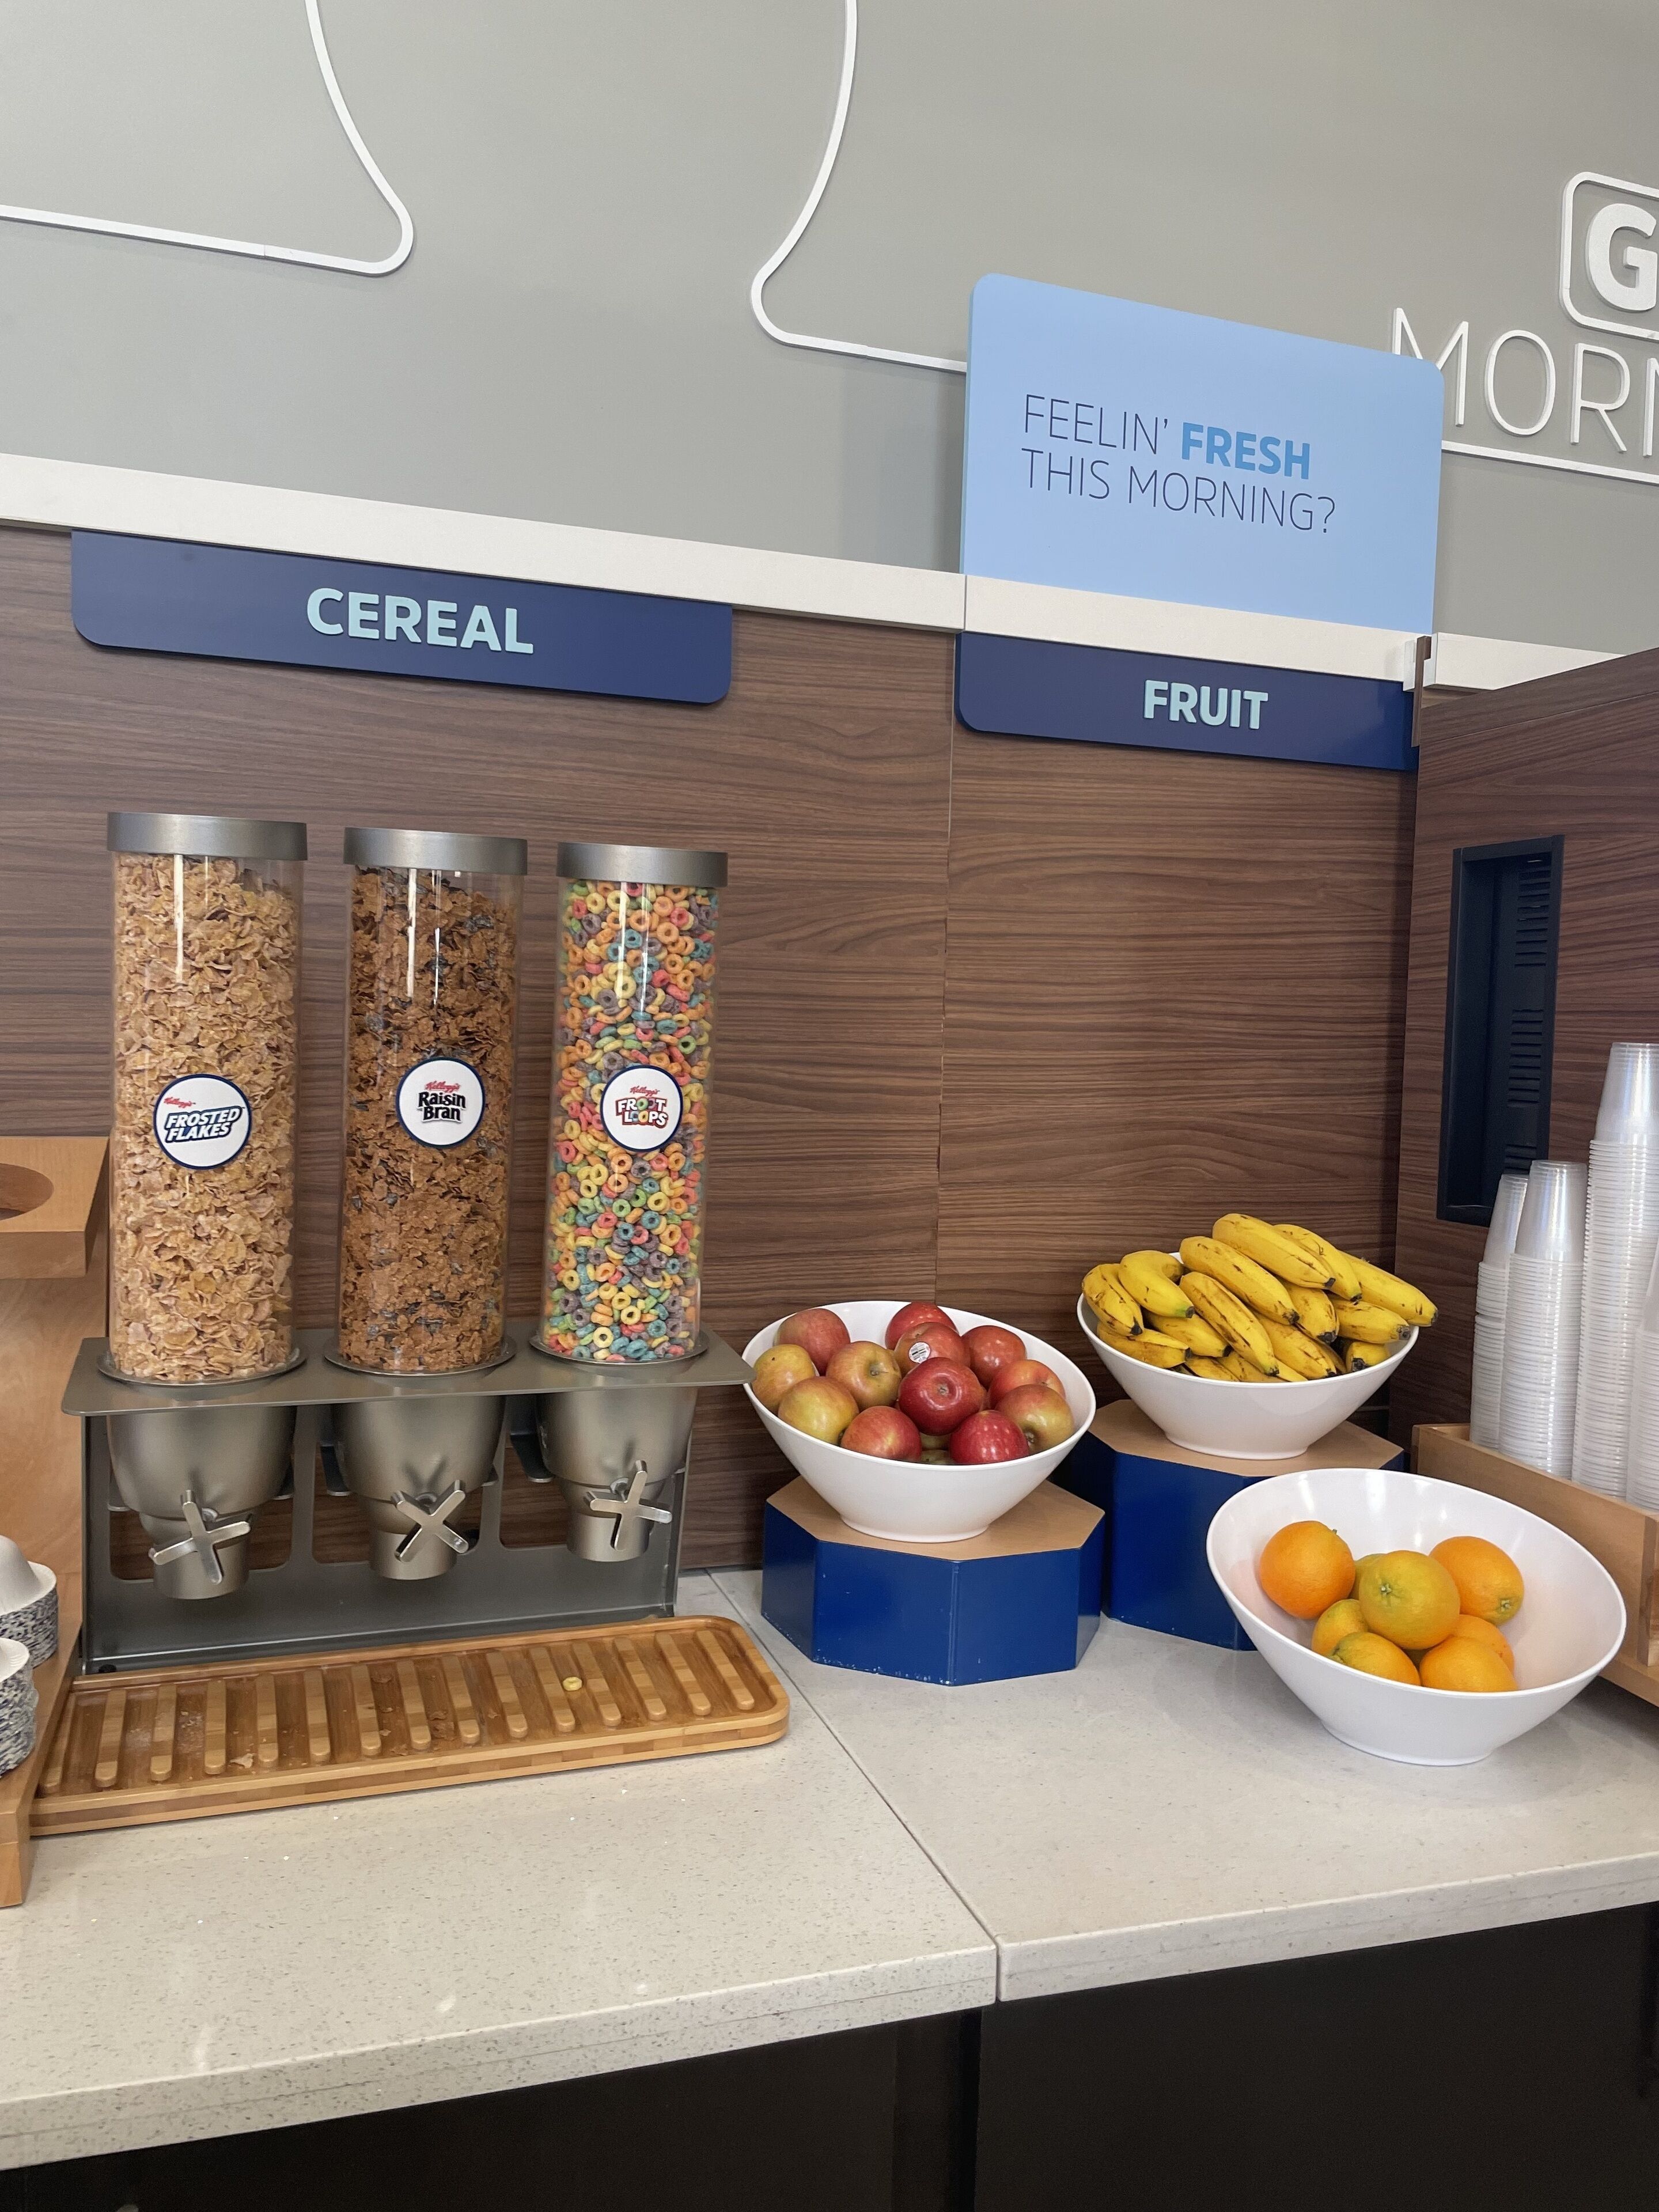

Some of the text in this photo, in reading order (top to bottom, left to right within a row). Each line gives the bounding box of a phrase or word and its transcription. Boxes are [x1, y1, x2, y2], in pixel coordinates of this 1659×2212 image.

[1586, 203, 1658, 312] G
[1024, 394, 1310, 480] FEELIN' FRESH
[1022, 448, 1335, 533] THIS MORNING?
[306, 588, 534, 654] CEREAL
[1143, 679, 1268, 730] FRUIT
[419, 1092, 466, 1108] Raisin
[618, 1097, 666, 1113] FROOT
[165, 1107, 241, 1128] FROSTED
[423, 1106, 461, 1121] Bran
[624, 1111, 668, 1127] LOOPS
[166, 1122, 231, 1142] FLAKES
